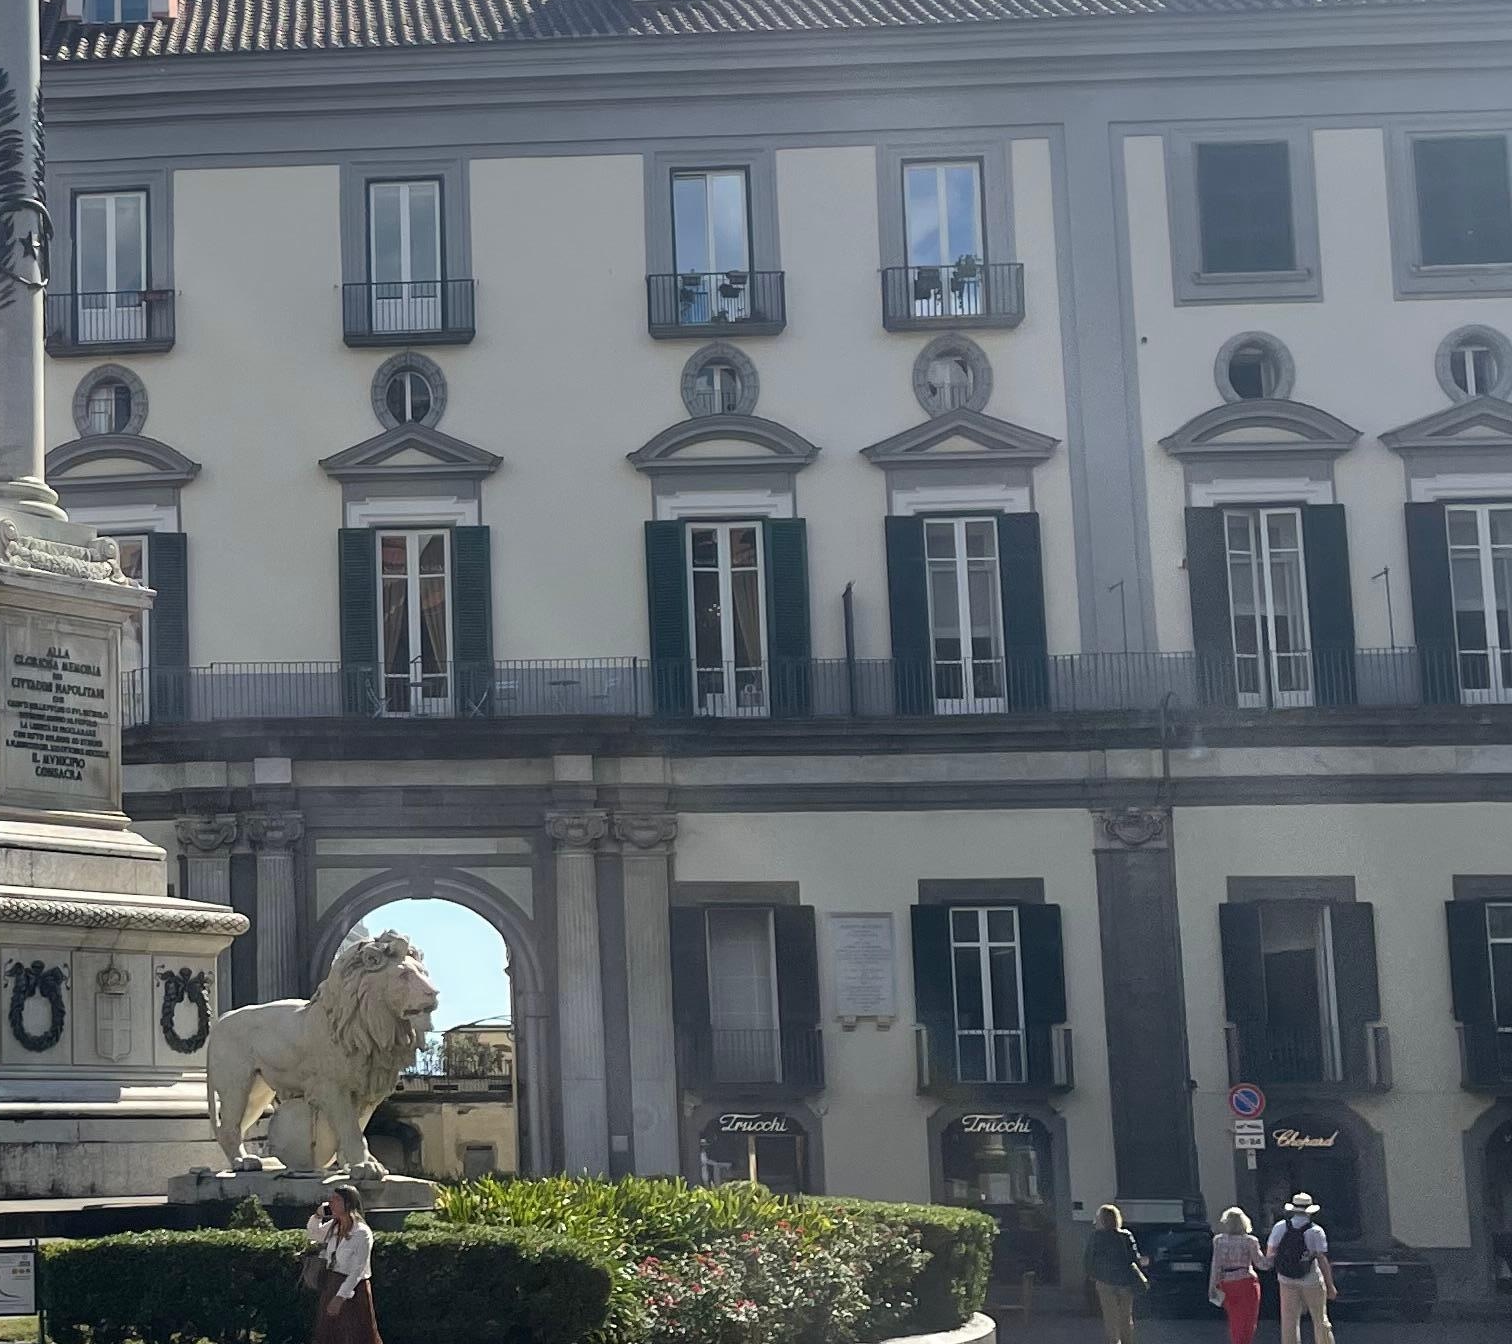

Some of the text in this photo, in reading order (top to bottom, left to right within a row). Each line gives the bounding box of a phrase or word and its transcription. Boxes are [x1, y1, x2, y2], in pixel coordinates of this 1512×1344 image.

[719, 1114, 790, 1132] Trucchi
[962, 1114, 1033, 1133] Trucchi
[1273, 1129, 1339, 1150] Chopard
